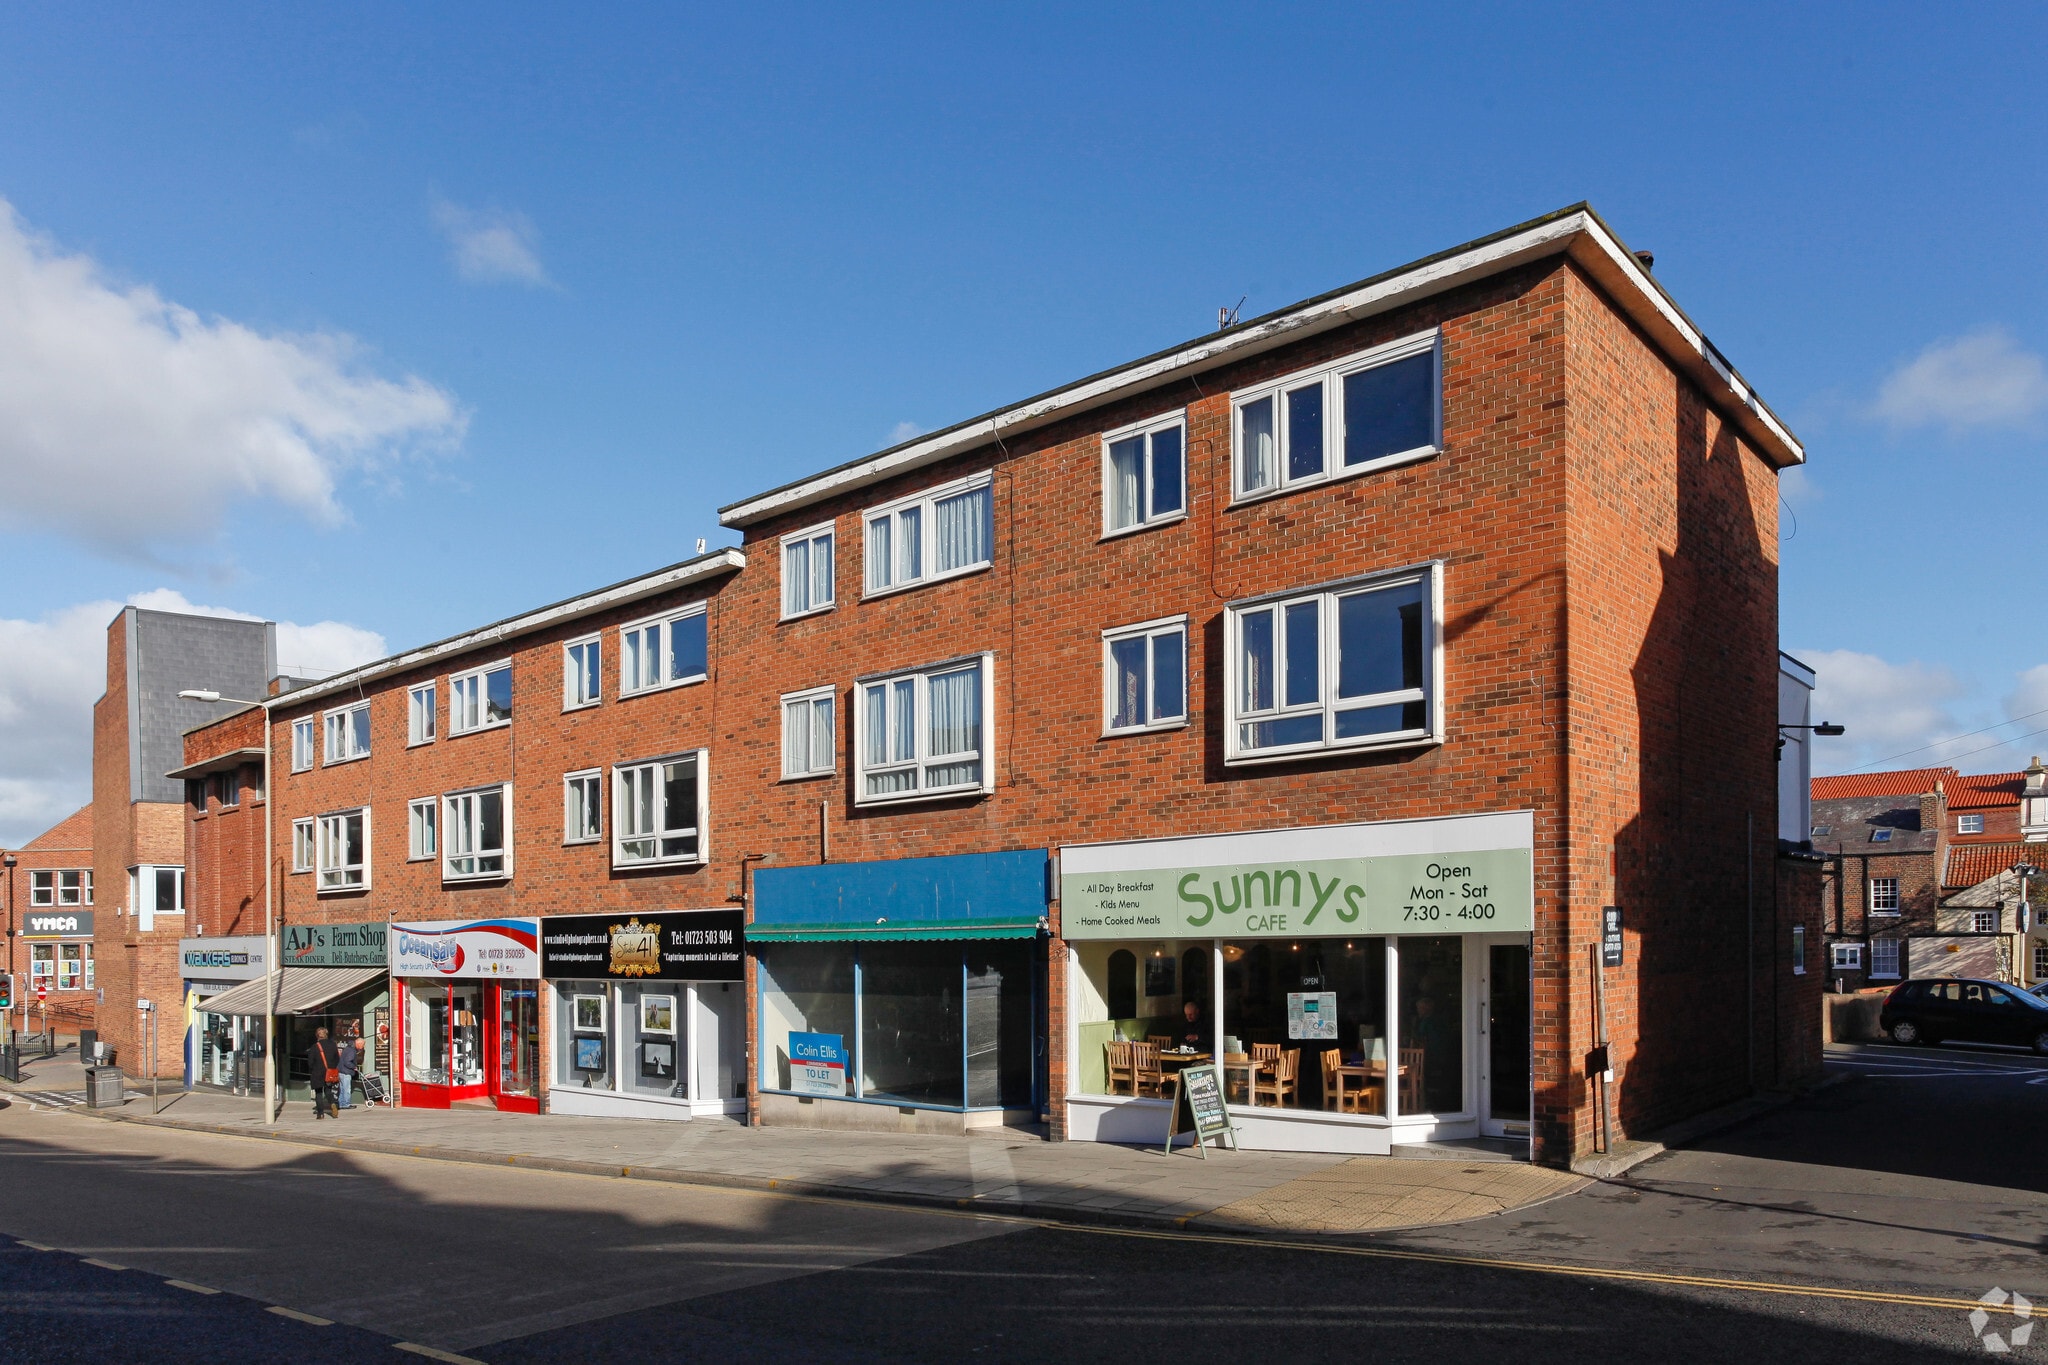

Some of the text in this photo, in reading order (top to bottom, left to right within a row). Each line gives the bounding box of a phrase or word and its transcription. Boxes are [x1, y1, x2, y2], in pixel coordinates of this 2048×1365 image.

[1426, 863, 1471, 882] Open
[1086, 884, 1096, 893] All
[1099, 884, 1114, 894] Day
[1117, 882, 1154, 892] Breakfast
[1410, 885, 1444, 900] Mon
[1462, 882, 1488, 898] Sat
[1100, 900, 1116, 909] Kids
[1119, 900, 1140, 908] Menu
[1177, 869, 1366, 928] Sunnys
[1403, 905, 1440, 921] 7:30
[1458, 903, 1495, 919] 4:00
[31, 916, 78, 931] YMCA
[1081, 917, 1102, 926] Home
[1104, 916, 1134, 925] Cooked
[1137, 915, 1160, 924] Meals
[1246, 914, 1287, 932] CAFE
[332, 927, 358, 946] Farm
[360, 924, 386, 951] Shop
[671, 930, 732, 945] Tel: 01723 503 904
[636, 936, 652, 958] 41
[250, 955, 262, 963] CENTRE
[284, 955, 325, 963] STEAK DINER
[370, 951, 386, 964] Game
[478, 949, 525, 959] Tel: 01723 350055
[709, 952, 717, 961] last
[400, 963, 409, 971] High
[1303, 977, 1319, 985] OPEN
[796, 1044, 837, 1058] Colin Ellis
[806, 1069, 829, 1079] TO LET
